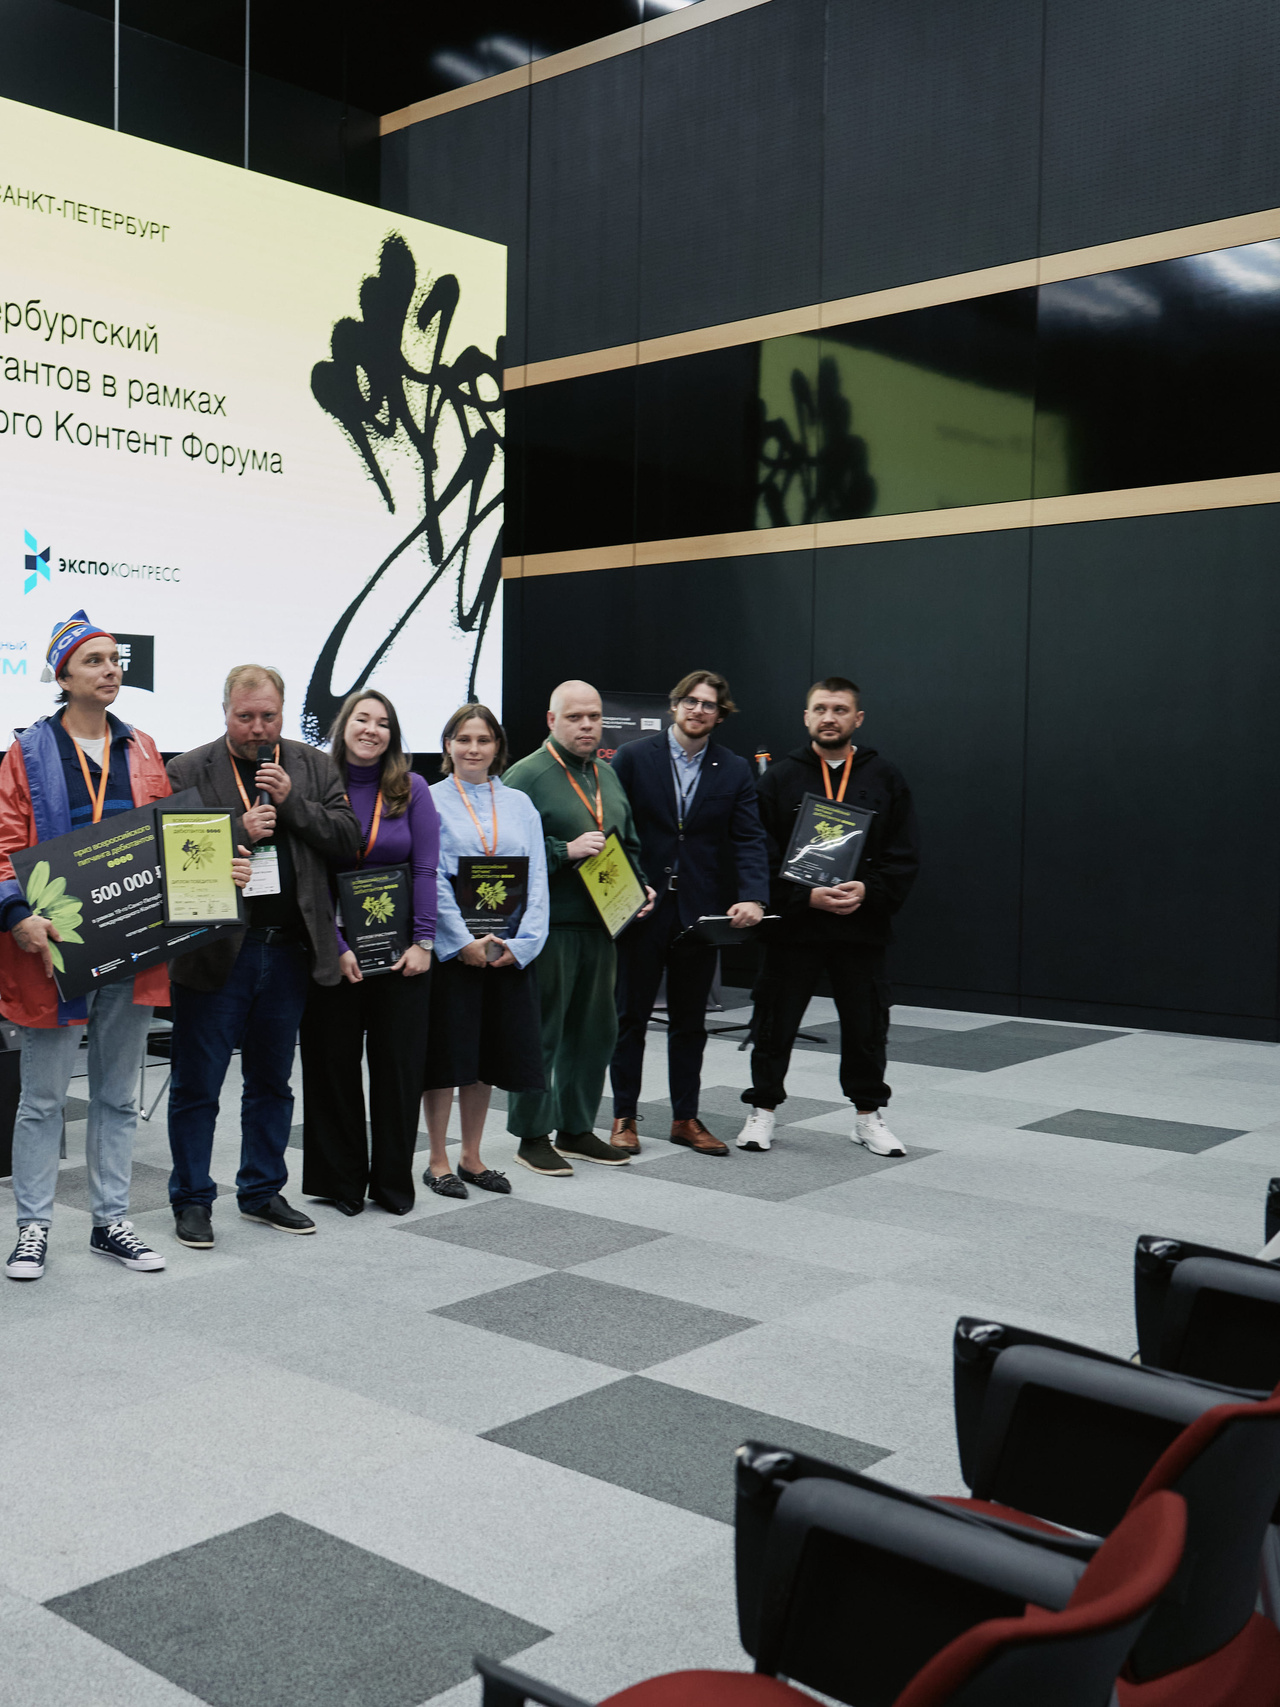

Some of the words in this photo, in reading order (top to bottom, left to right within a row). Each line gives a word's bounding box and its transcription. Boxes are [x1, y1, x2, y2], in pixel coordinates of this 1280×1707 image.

[102, 374, 117, 398] в
[127, 378, 228, 418] рамках
[54, 410, 172, 459] Контент
[181, 432, 284, 476] Форума
[58, 557, 182, 583] ЭКСПОКОНГРЕСС
[92, 825, 151, 851] всероссийского
[111, 834, 155, 856] дебютантов
[91, 882, 122, 904] 500
[123, 869, 154, 892] 000
